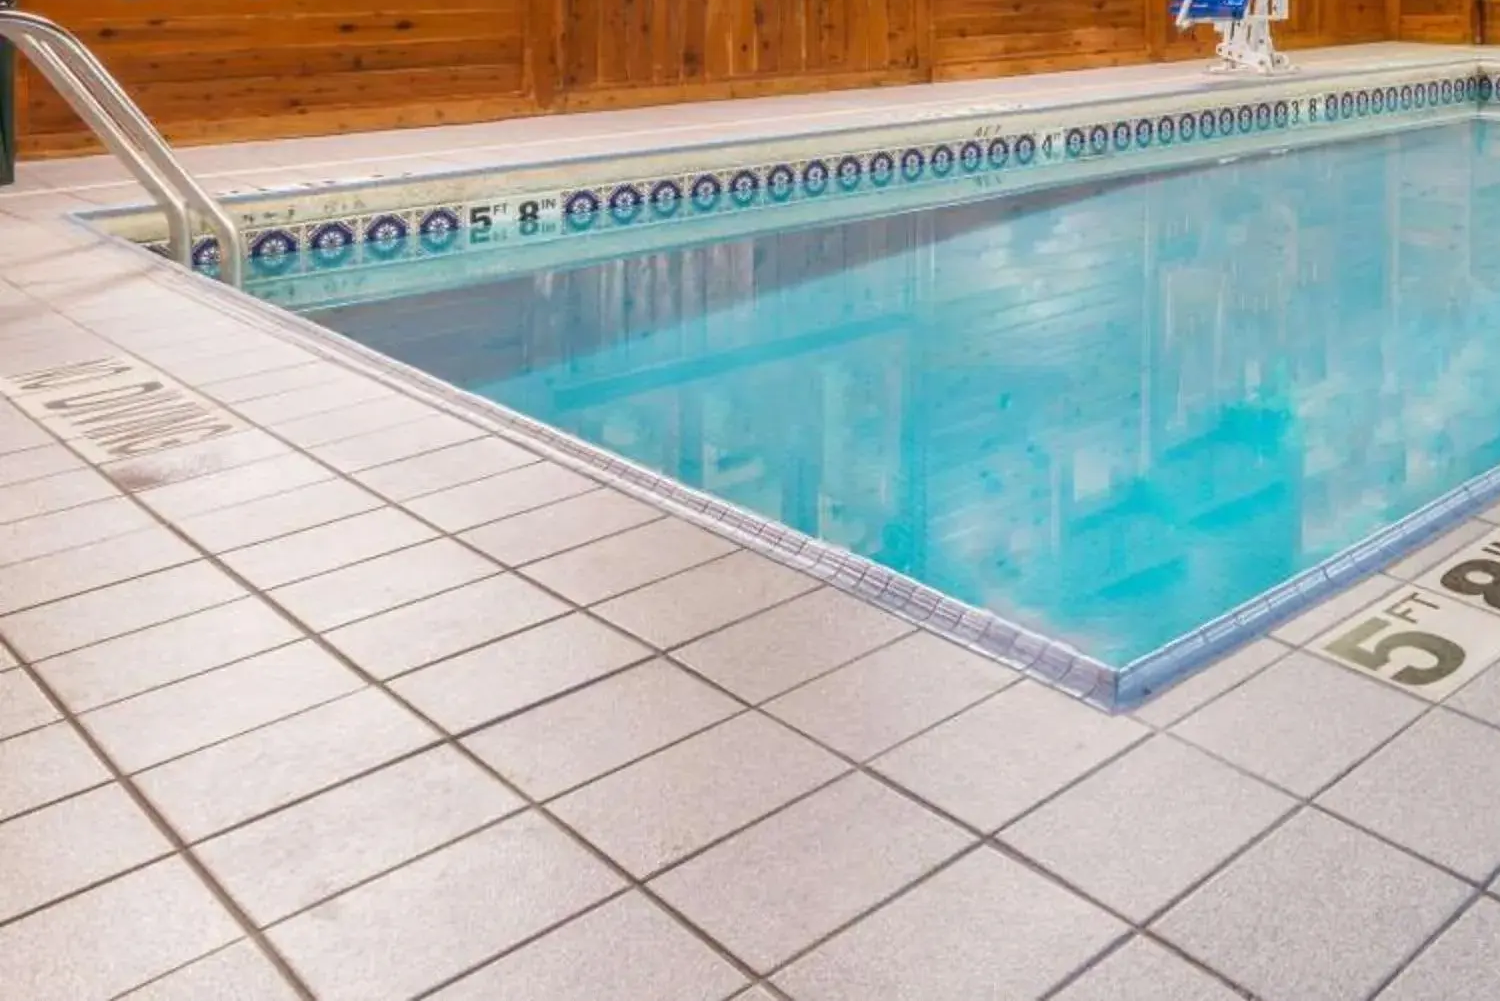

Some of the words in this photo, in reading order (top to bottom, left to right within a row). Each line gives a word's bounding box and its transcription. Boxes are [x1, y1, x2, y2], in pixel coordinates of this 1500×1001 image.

[469, 206, 492, 230] 5
[518, 200, 538, 225] 8
[541, 198, 556, 210] IN
[1383, 592, 1441, 624] FT
[1324, 616, 1466, 686] 5
